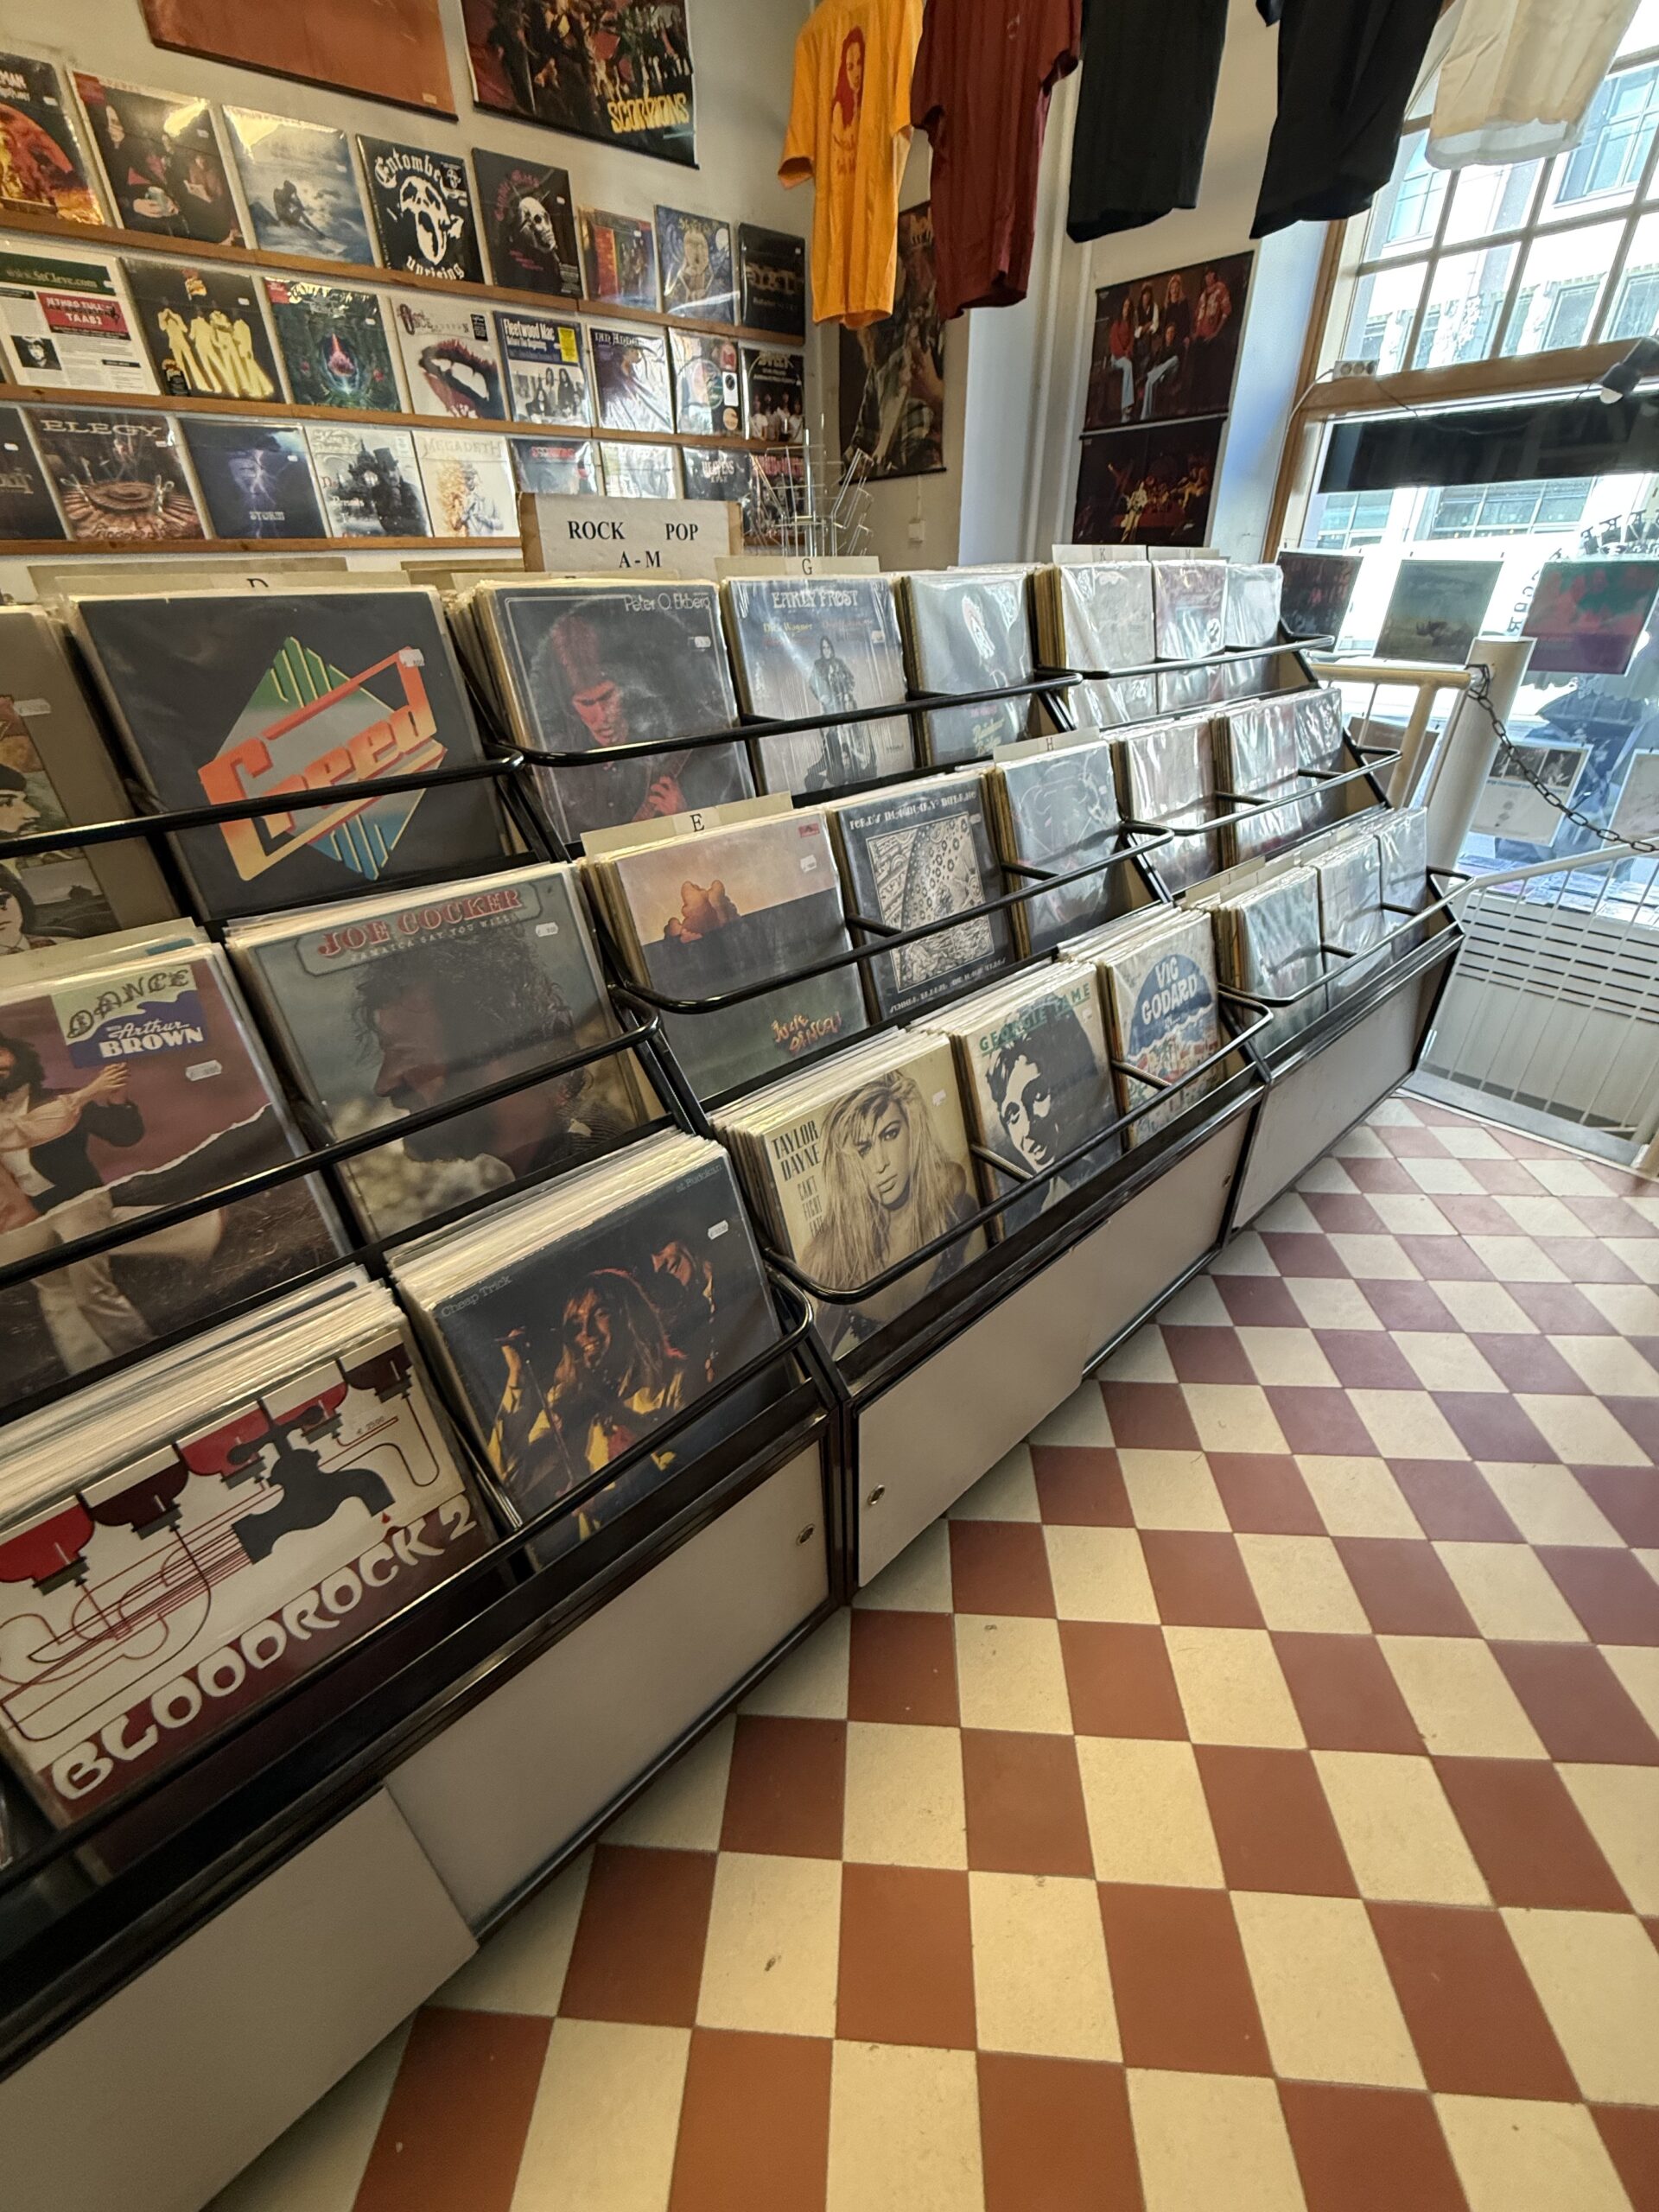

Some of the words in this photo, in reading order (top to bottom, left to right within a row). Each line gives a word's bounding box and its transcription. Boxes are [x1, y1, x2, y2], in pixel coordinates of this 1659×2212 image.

[607, 92, 689, 134] SCORPIONS
[406, 255, 465, 280] uprising
[66, 313, 103, 326] TAAB2
[503, 318, 540, 339] Fleetwood
[540, 322, 555, 341] Mac
[40, 420, 162, 437] ELEGY
[423, 439, 503, 457] MEGADETH
[567, 520, 626, 541] ROCK
[665, 523, 700, 542] POP
[645, 550, 662, 569] M
[802, 558, 813, 576] G
[624, 594, 655, 612] Peter
[772, 590, 817, 609] EARLY
[820, 589, 858, 607] FROST
[1046, 738, 1054, 752] H
[198, 645, 448, 881] Creed
[690, 812, 706, 833] E
[317, 919, 391, 957] JOE
[397, 888, 523, 936] COCKER
[350, 938, 415, 963] JAMAICA
[420, 928, 447, 944] SAY
[450, 921, 476, 937] YOU
[1154, 957, 1179, 988] VIC
[67, 969, 190, 1039] DANCE
[1141, 973, 1198, 1025] GODARD
[108, 1017, 189, 1040] Arthur
[978, 1005, 1048, 1053] GEORGIE
[1052, 982, 1090, 1016] FAME
[99, 1027, 205, 1058] BROWN
[772, 1120, 819, 1160] TAYLOR
[780, 1142, 822, 1181] DAYNE
[685, 1164, 723, 1189] Budokan
[442, 1293, 480, 1317] Cheap
[479, 1275, 512, 1297] Trick
[51, 1523, 446, 1801] BLOODROCK
[439, 1493, 479, 1541] 2
